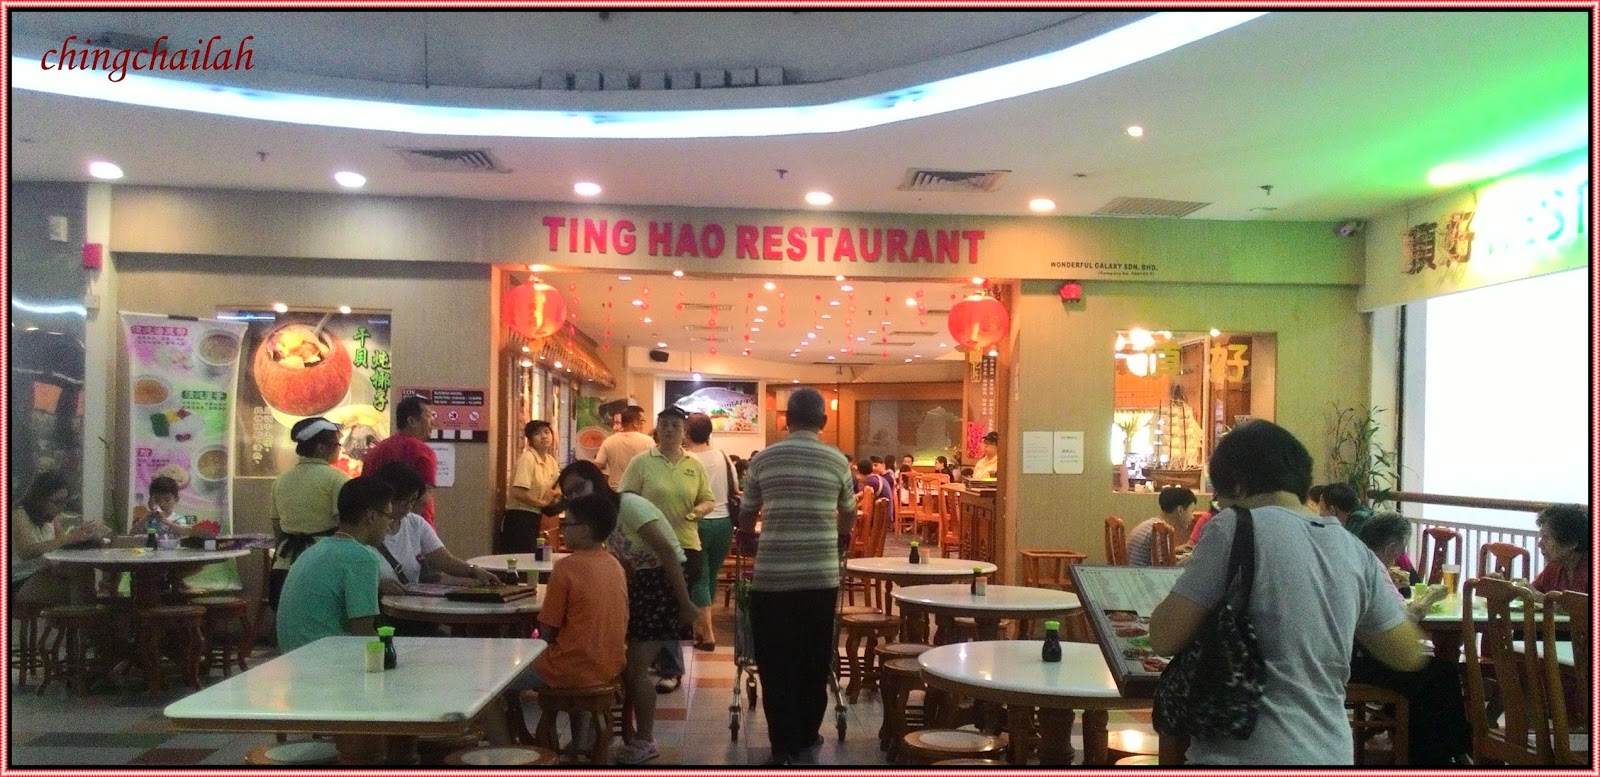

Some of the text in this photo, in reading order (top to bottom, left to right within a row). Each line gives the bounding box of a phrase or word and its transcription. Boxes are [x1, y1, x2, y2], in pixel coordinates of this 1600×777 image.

[542, 215, 986, 265] TING HAO RESTAURANT
[1050, 261, 1159, 272] WONDERFUL GALAXY SDN. BHD.
